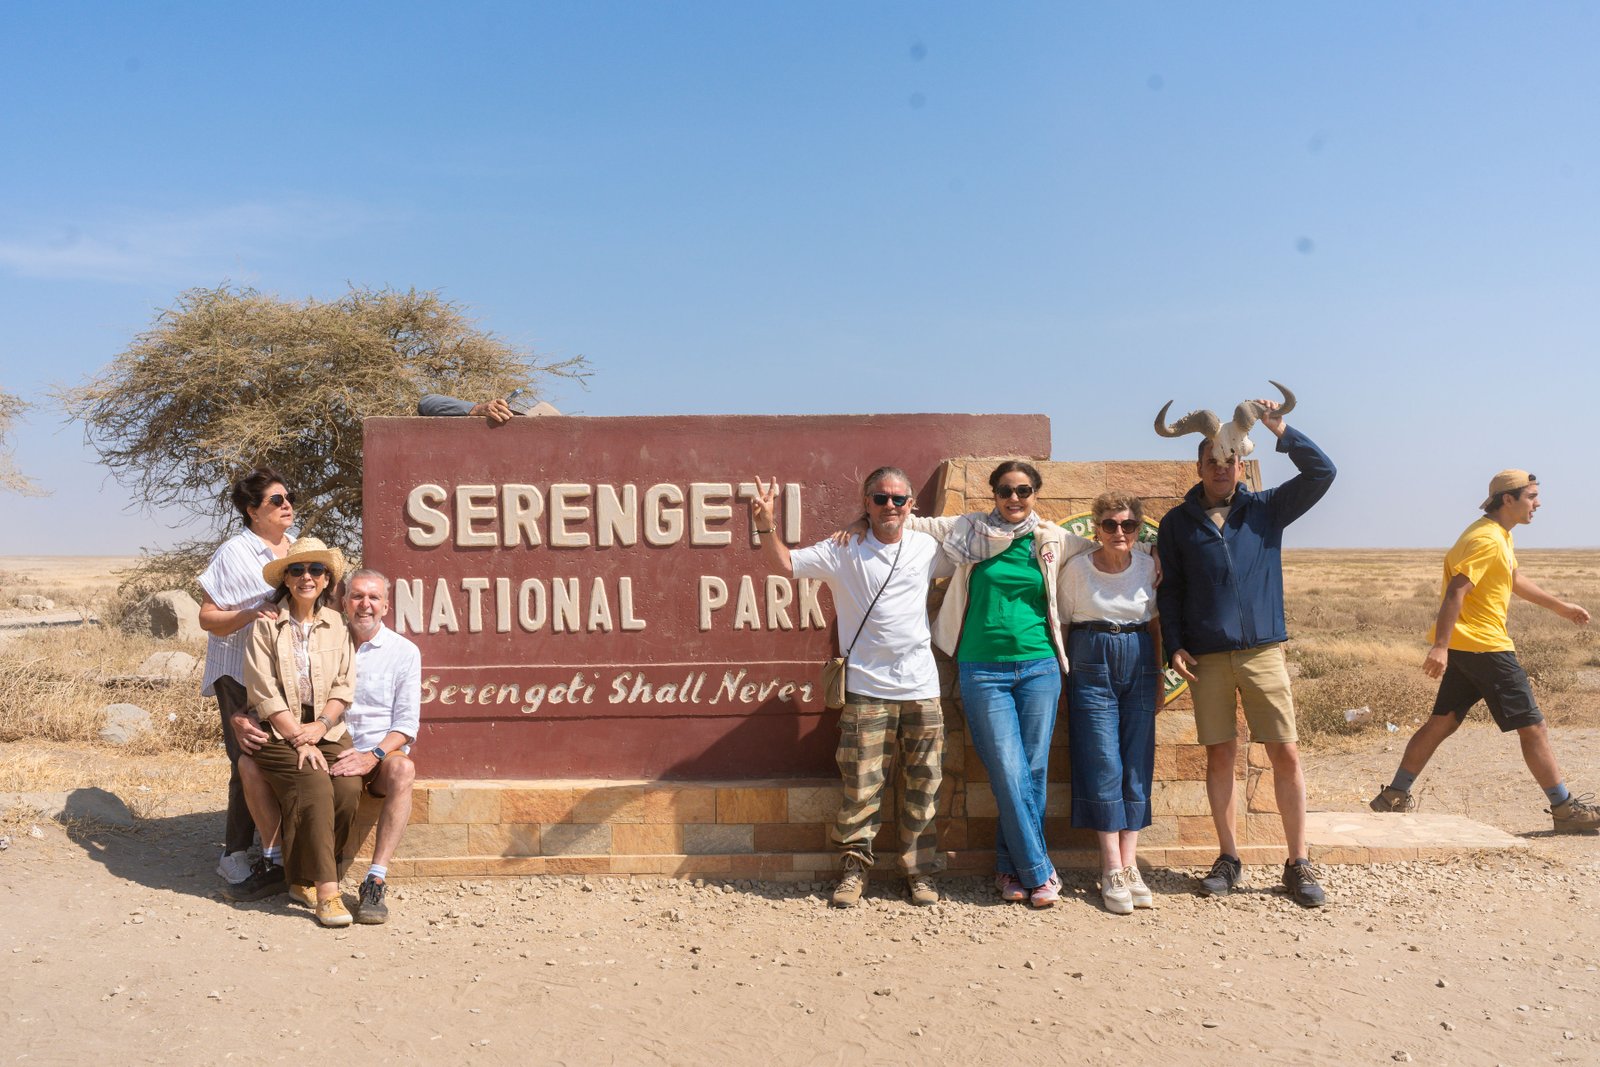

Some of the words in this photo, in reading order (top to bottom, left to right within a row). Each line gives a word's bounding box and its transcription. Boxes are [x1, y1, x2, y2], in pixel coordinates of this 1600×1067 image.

[407, 482, 803, 548] SERENGETI
[394, 576, 647, 634] NATIONAL
[699, 574, 827, 632] PARK
[420, 671, 600, 714] Serengeti
[608, 670, 708, 705] Shall
[708, 668, 814, 705] Never
